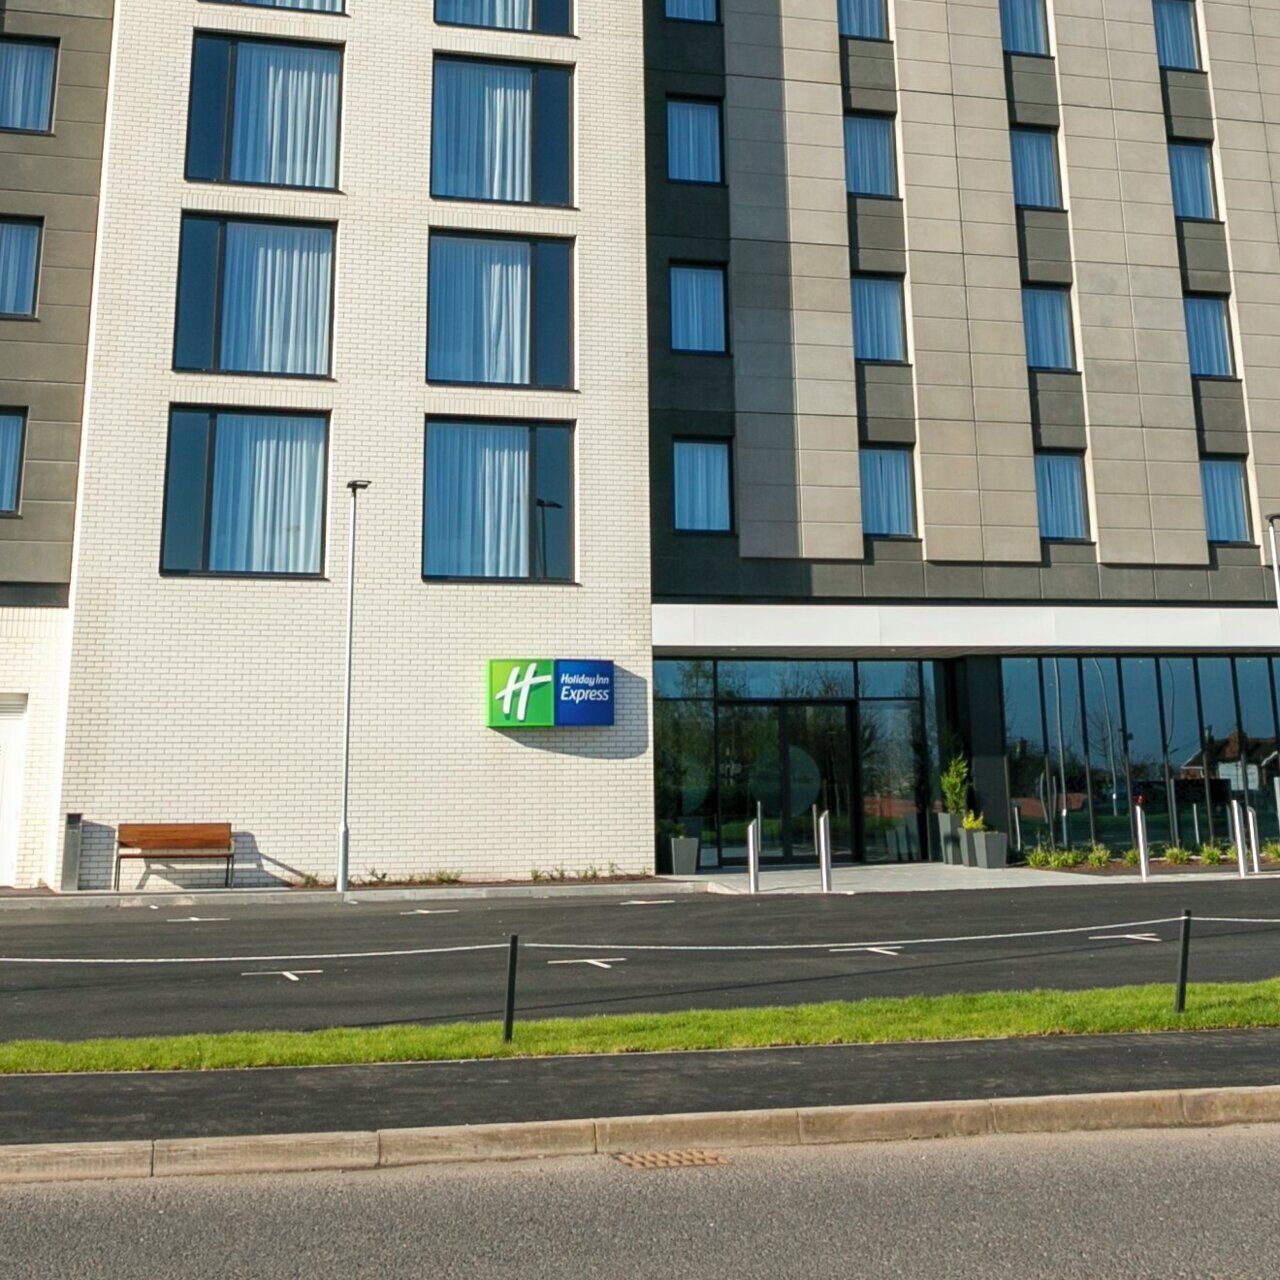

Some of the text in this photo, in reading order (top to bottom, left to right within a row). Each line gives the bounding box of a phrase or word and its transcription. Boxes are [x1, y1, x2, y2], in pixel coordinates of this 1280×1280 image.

[560, 673, 610, 687] Holiday Inn
[560, 686, 610, 704] Express
